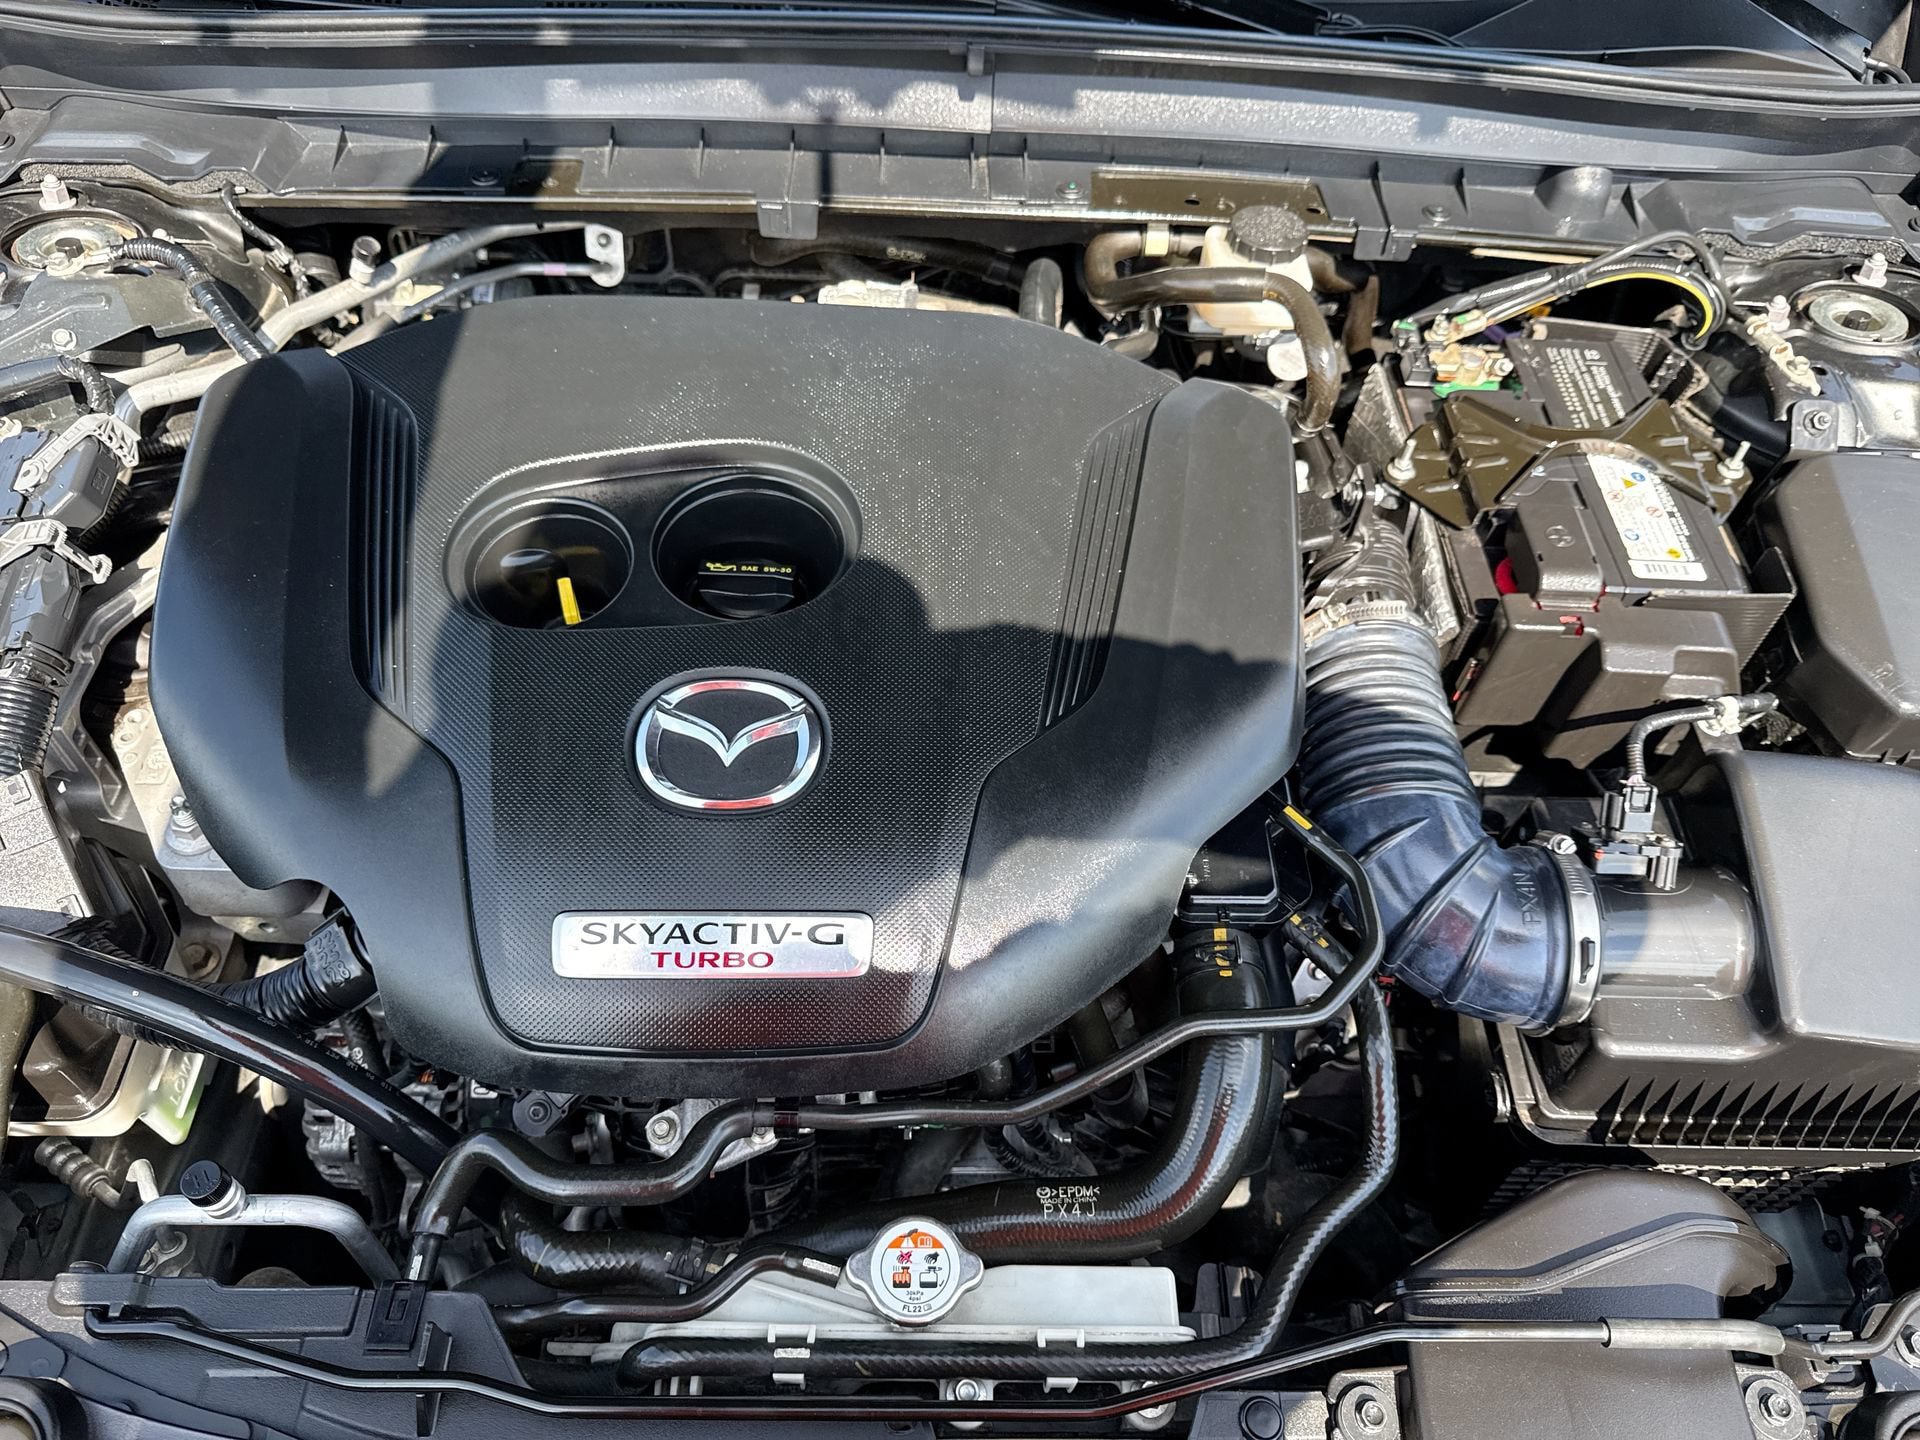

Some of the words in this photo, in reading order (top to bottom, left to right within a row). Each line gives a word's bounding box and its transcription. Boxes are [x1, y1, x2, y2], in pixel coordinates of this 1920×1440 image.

[580, 922, 845, 946] SKYACTIV-G
[651, 951, 774, 969] TURBO
[169, 1056, 192, 1106] LOW
[902, 1304, 922, 1313] FL22
